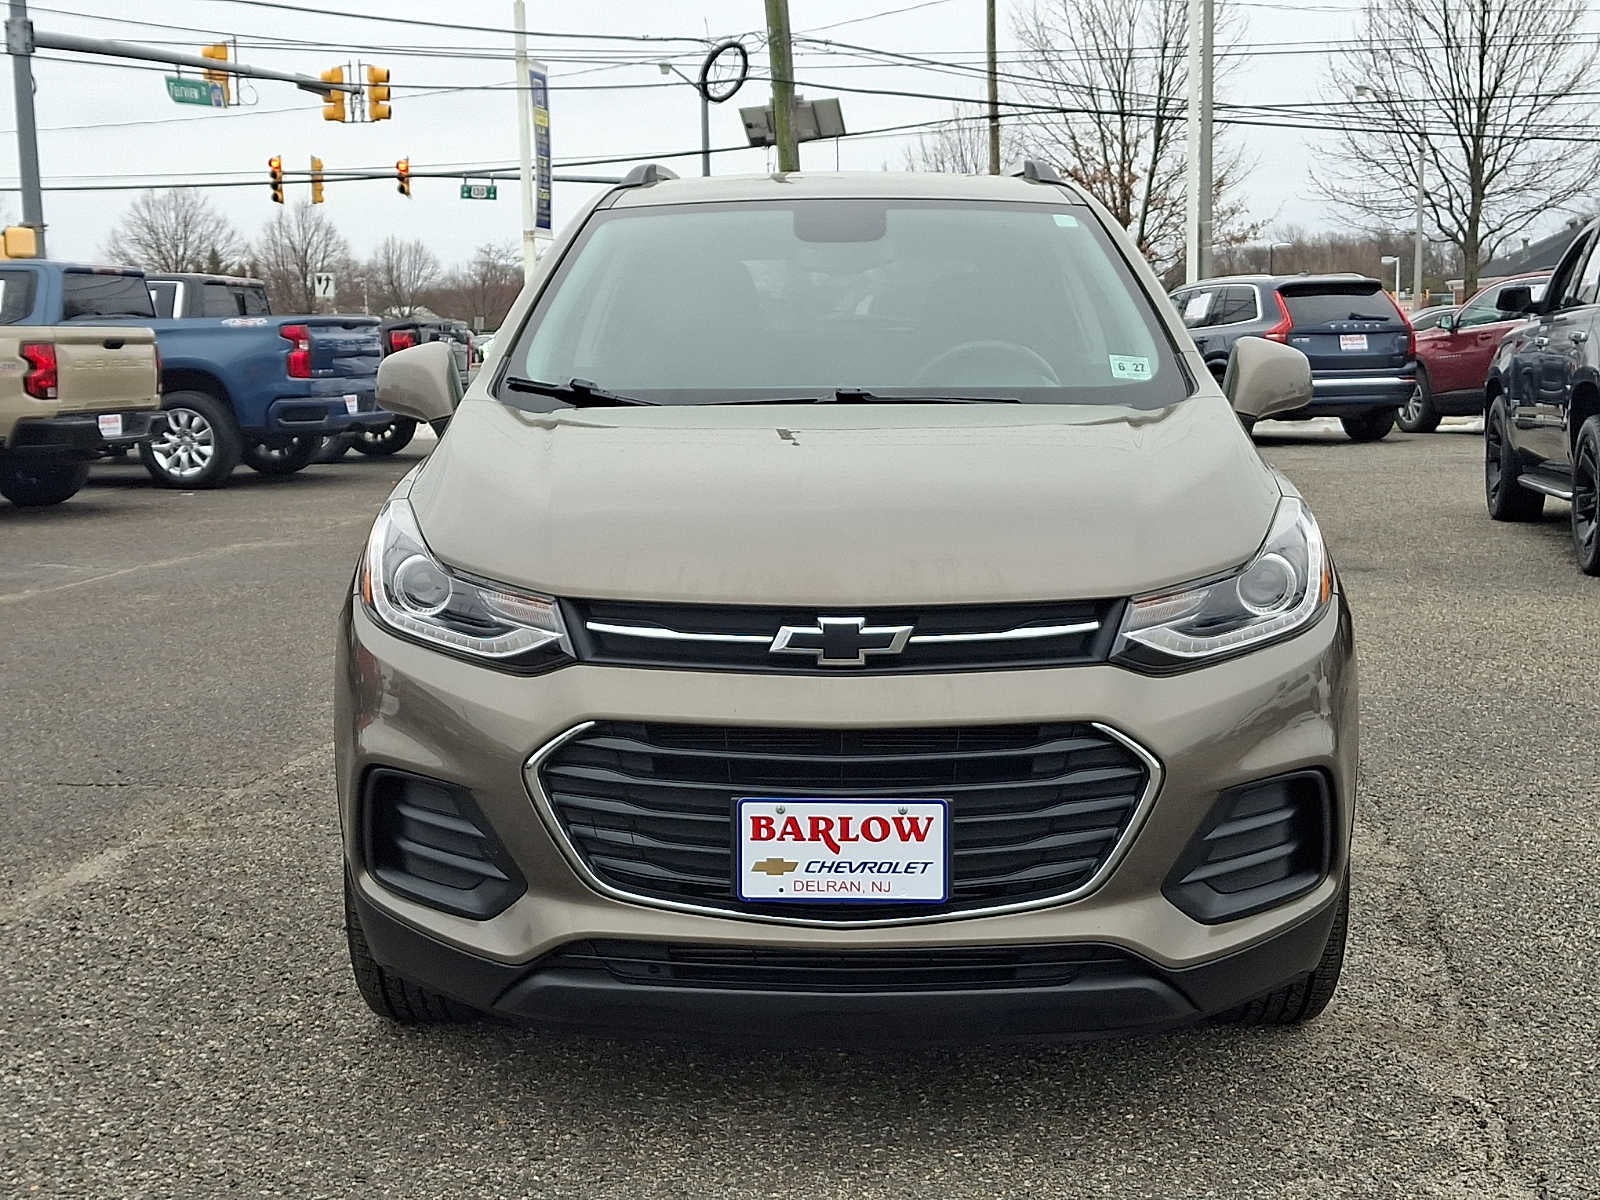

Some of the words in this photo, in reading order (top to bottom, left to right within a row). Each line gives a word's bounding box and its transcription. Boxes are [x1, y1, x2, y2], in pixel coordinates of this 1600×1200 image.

[1118, 362, 1126, 371] 6
[1132, 362, 1144, 372] 27
[749, 815, 935, 855] BARLOW
[804, 860, 934, 875] CHEVROLET
[793, 880, 865, 894] DELRAN,
[871, 881, 892, 893] NJ
